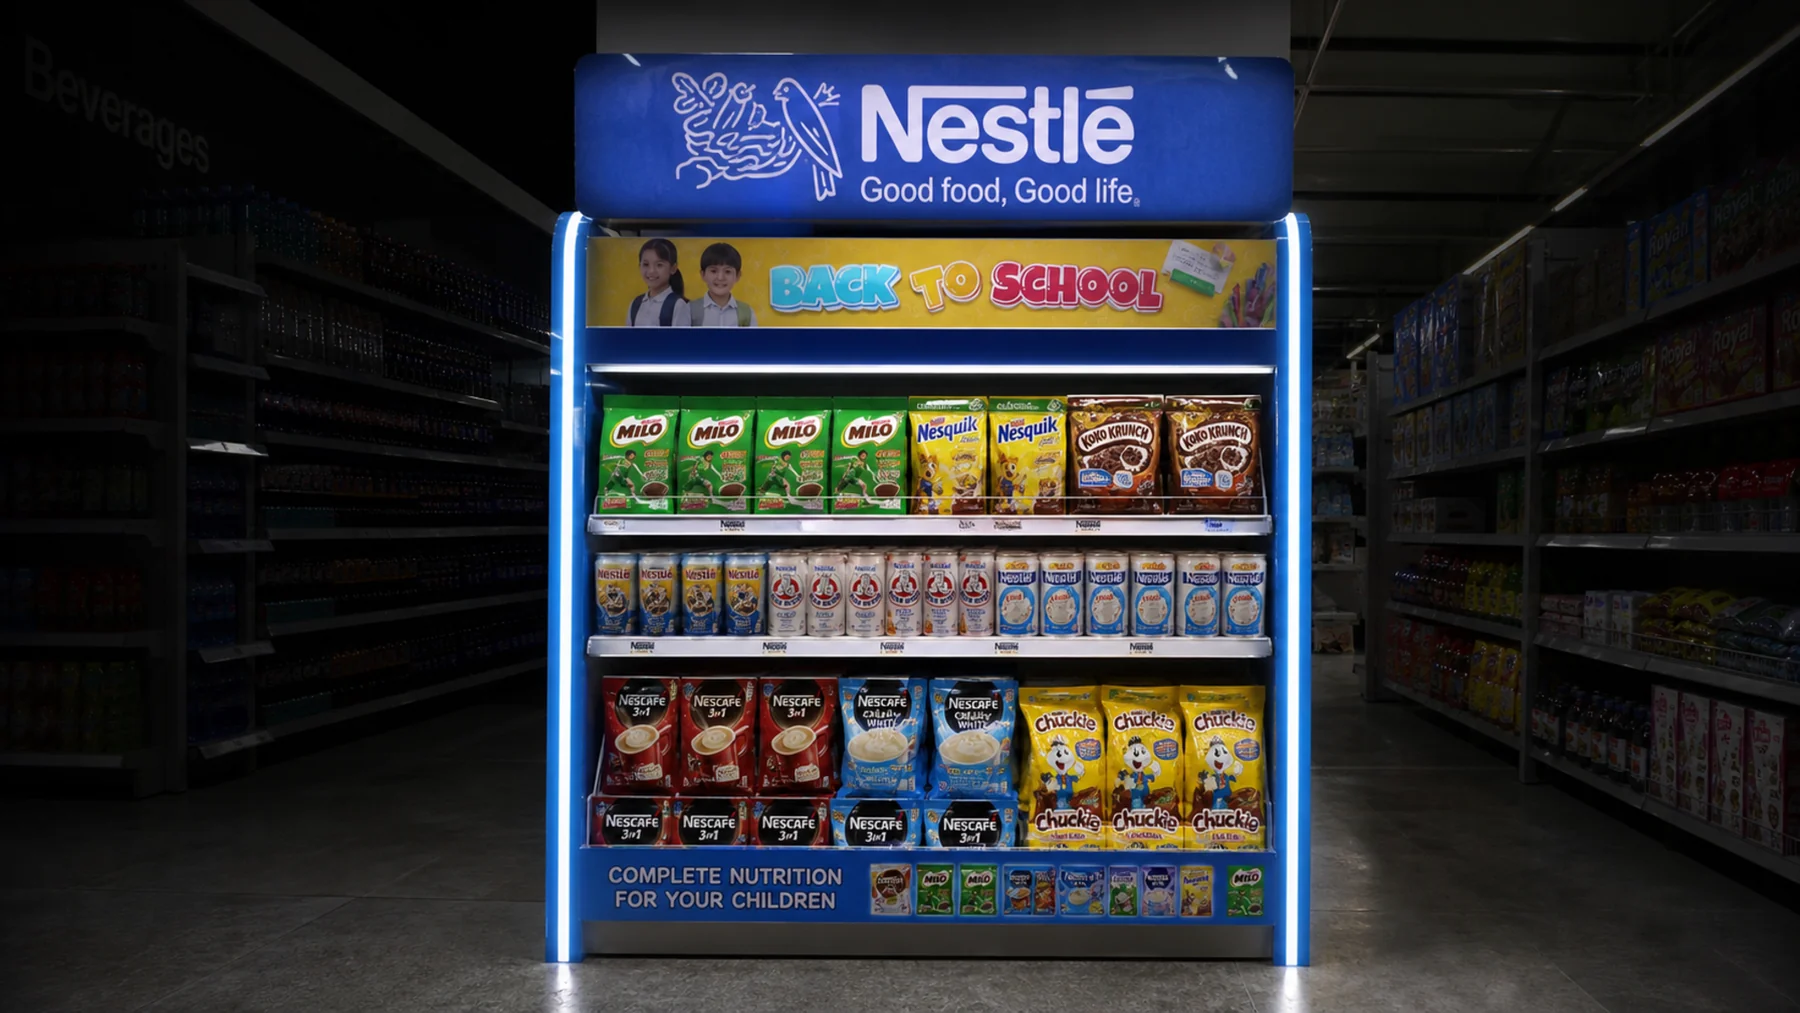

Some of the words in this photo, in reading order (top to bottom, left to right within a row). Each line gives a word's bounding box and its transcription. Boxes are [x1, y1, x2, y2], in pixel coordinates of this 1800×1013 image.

[25, 34, 210, 174] Beverages
[860, 84, 1135, 165] Nestlé
[861, 175, 934, 203] Good
[941, 176, 1007, 207] food,
[1015, 176, 1087, 204] Good
[769, 263, 902, 312] BACK
[910, 260, 983, 313] TO
[990, 260, 1164, 312] SCHOOL
[1712, 313, 1755, 355] Royal
[616, 422, 663, 440] MILO
[694, 423, 742, 442] MILO
[771, 423, 818, 442] MILO
[848, 423, 893, 441] MILO
[917, 415, 979, 444] Nesquik
[997, 415, 1058, 444] Nesquik
[1081, 429, 1107, 450] KOKO
[1108, 423, 1149, 440] KRUNCH
[1183, 430, 1208, 449] KOKO
[1208, 424, 1248, 441] KRUNCH
[1035, 710, 1097, 732] Chuckie
[1113, 711, 1175, 732] Chuckie
[1193, 711, 1256, 732] Chuckie
[1113, 808, 1178, 832] Chuckie
[1192, 808, 1259, 832] Chuckie
[608, 866, 722, 884] COMPLETE
[730, 867, 842, 886] NUTRITION
[615, 890, 658, 908] FOR
[665, 891, 724, 909] YOUR
[731, 891, 836, 910] CHILDREN
